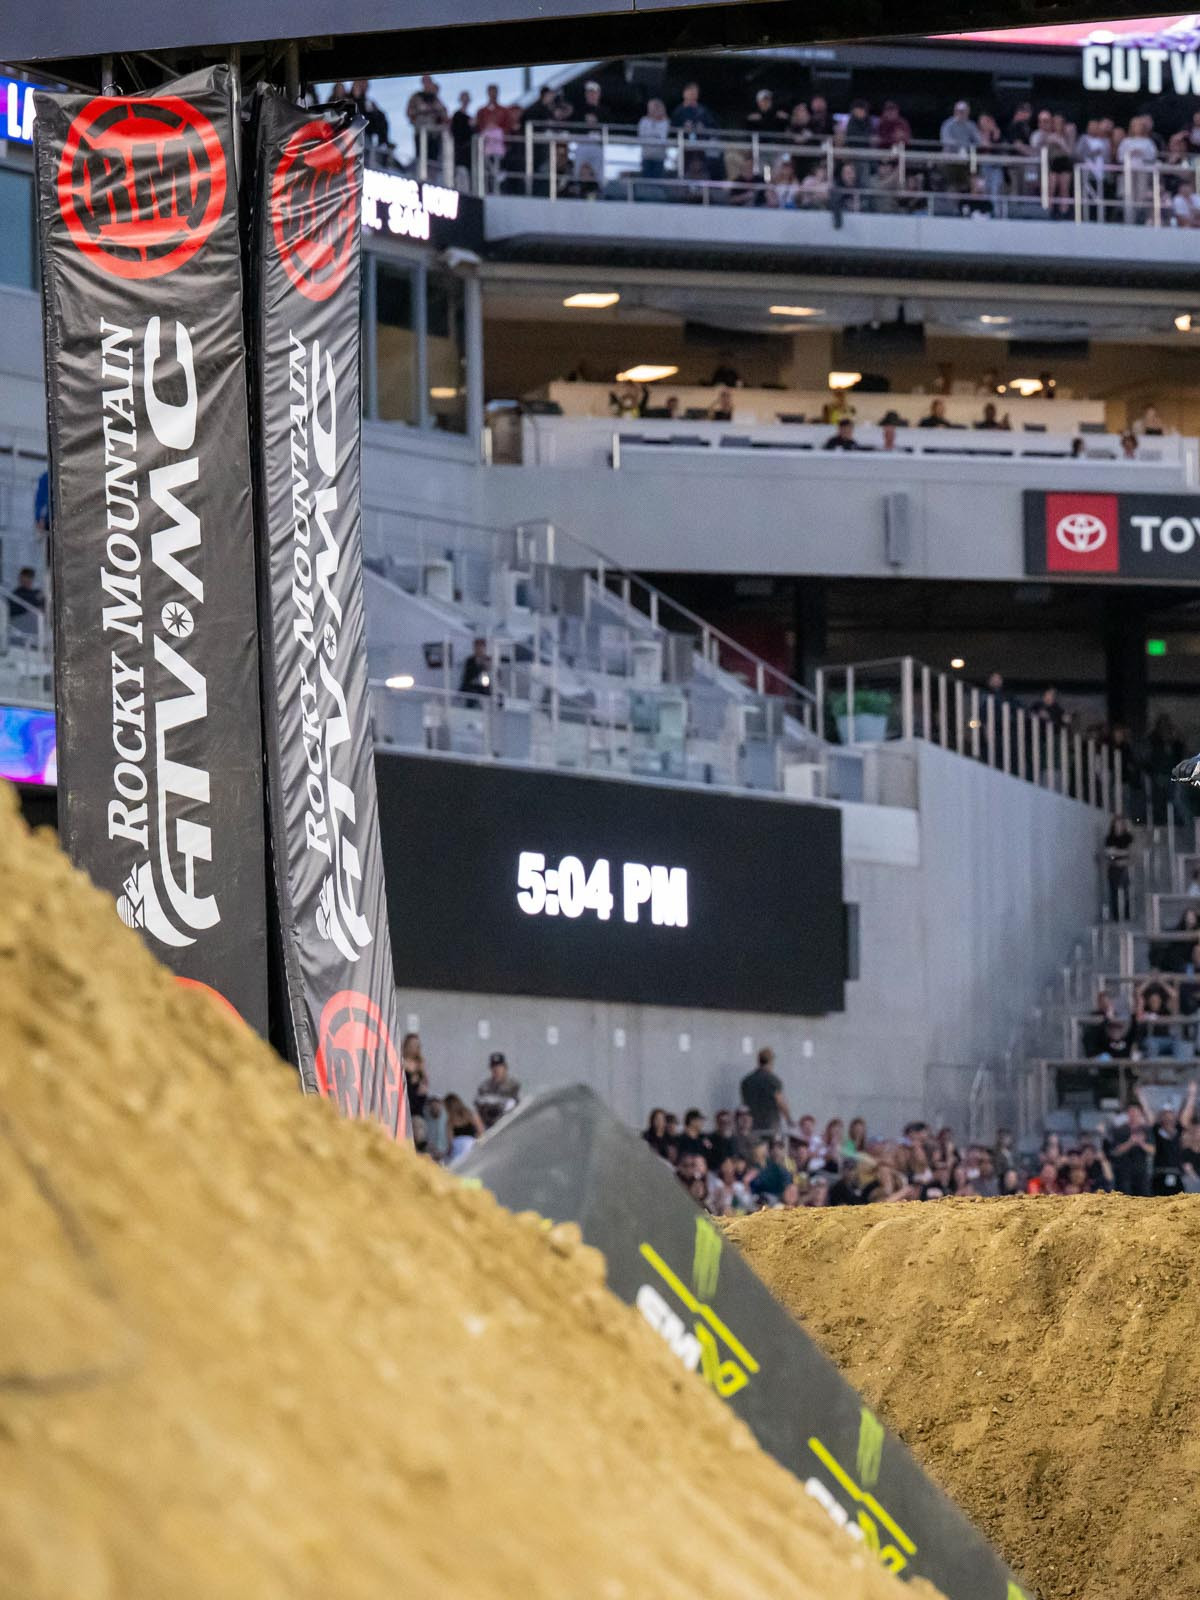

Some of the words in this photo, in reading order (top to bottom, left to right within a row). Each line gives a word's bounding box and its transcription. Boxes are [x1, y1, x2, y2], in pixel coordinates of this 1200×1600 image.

[100, 318, 143, 644] MOUNTAIN
[289, 329, 318, 659] MOUNTAIN
[108, 651, 149, 850] ROCKY
[298, 662, 333, 863] ROCKY
[517, 851, 614, 921] 5:04
[623, 862, 688, 927] PM
